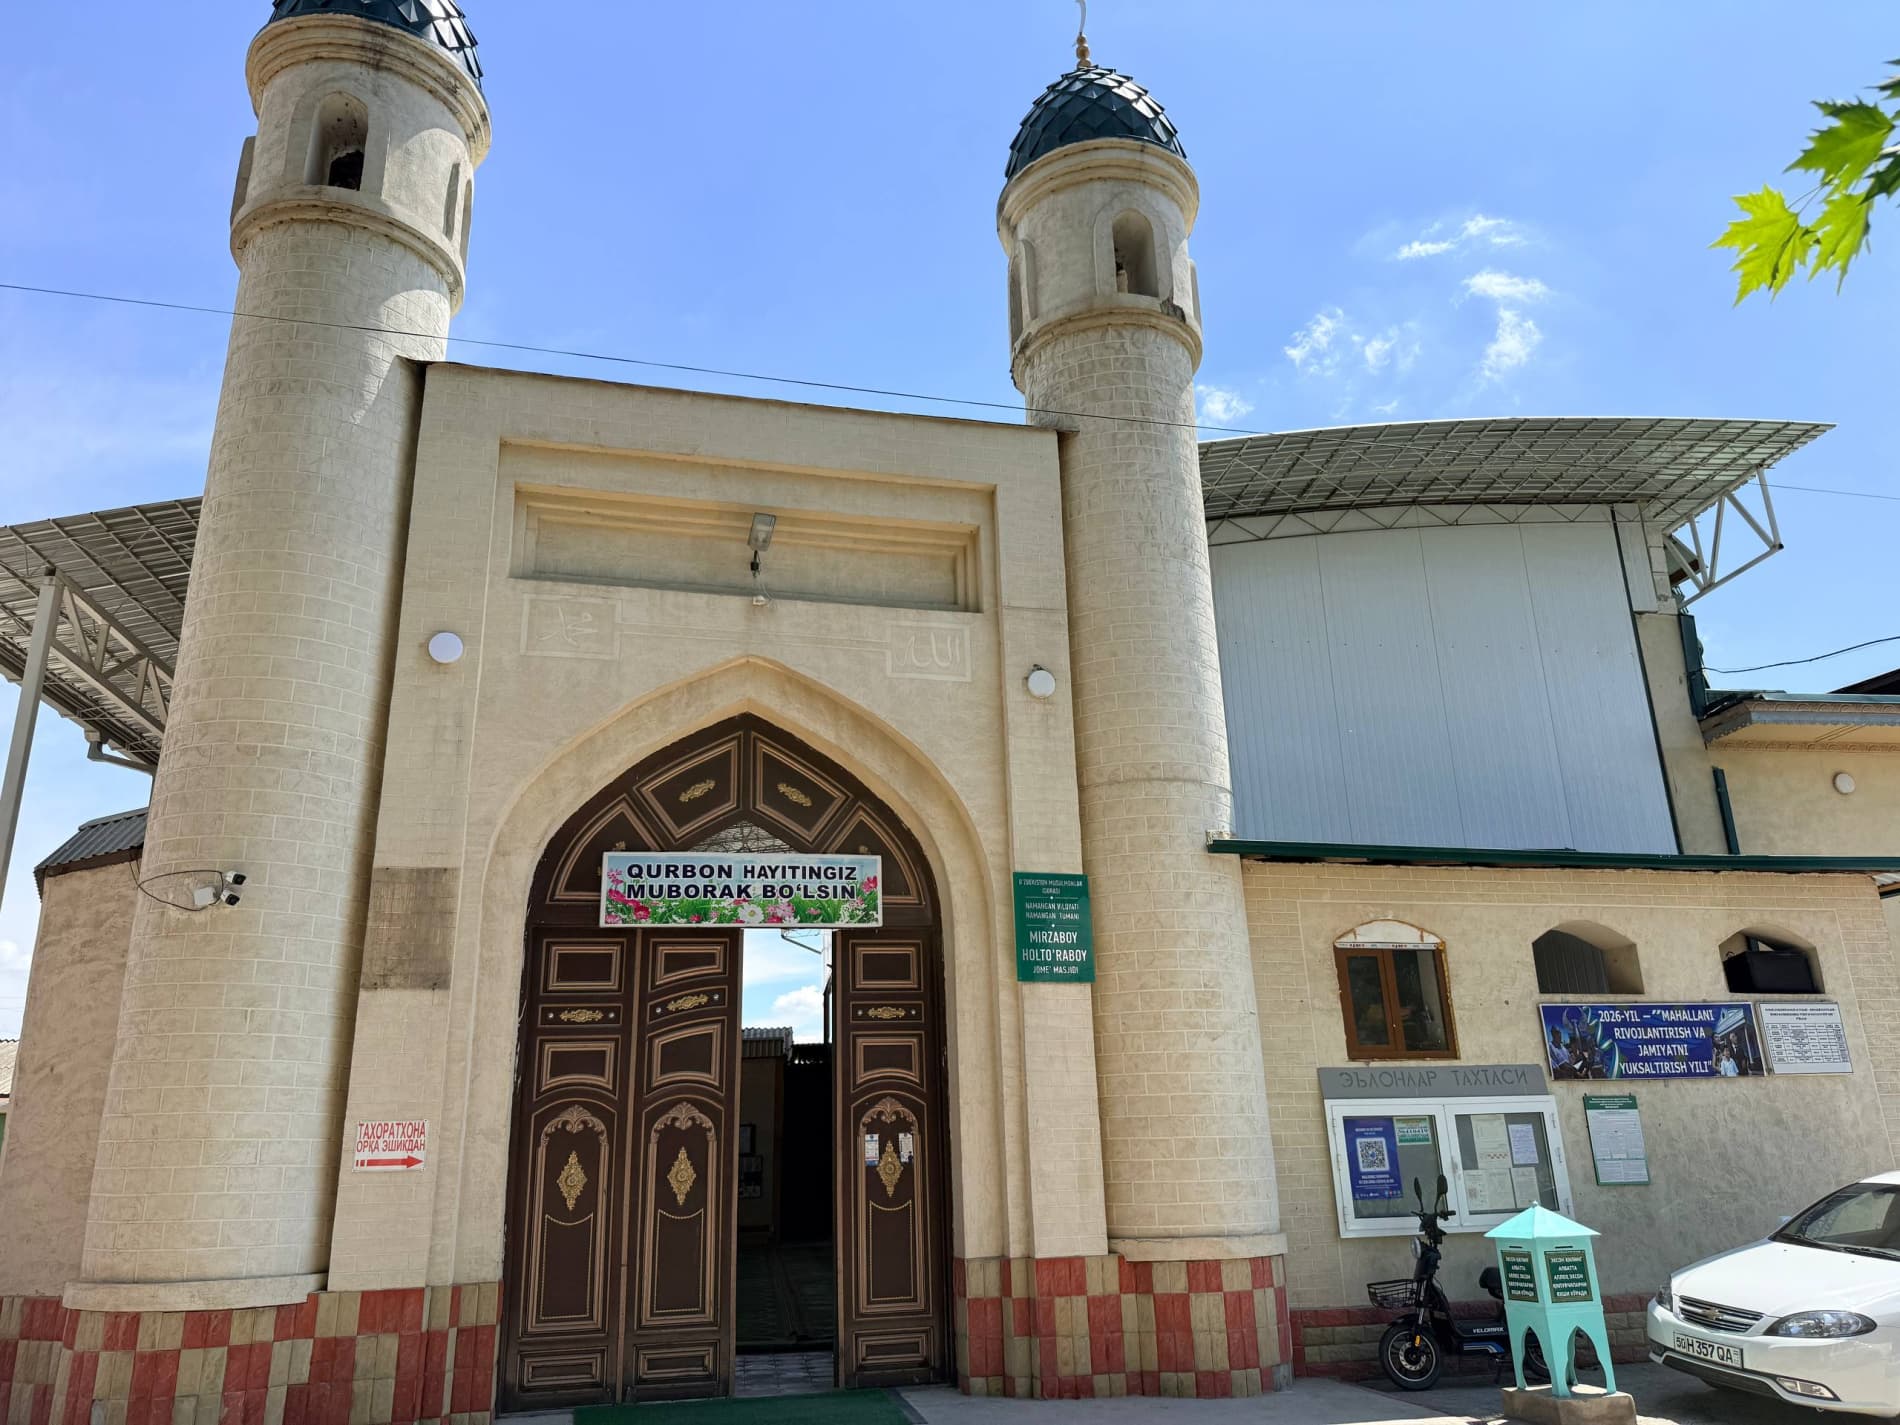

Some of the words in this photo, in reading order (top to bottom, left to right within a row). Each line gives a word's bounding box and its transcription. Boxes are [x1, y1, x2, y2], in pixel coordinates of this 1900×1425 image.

[627, 863, 733, 880] QURBON
[743, 864, 857, 881] HAYITINGIZ
[627, 884, 752, 899] MUBORAK
[1025, 902, 1056, 910] NAMANGAN
[1025, 911, 1056, 919] NAMANGAN
[1059, 912, 1080, 920] TUMANI
[1029, 931, 1078, 943] MIRZABOY
[1053, 966, 1079, 974] MASJIDI
[1598, 1010, 1640, 1023] 2026-YIL
[1614, 1027, 1691, 1040] RIVOJLANTIRISH
[1693, 1027, 1706, 1039] VA
[1638, 1044, 1689, 1057] JAMIYATNI
[1619, 1061, 1687, 1075] YUKSALTIRISH
[1339, 1071, 1437, 1088] ЭЪЛОНЛАР
[1452, 1069, 1528, 1086] ТАХТАСИ
[358, 1122, 426, 1139] ТАХОРАТХОНА
[1676, 1336, 1686, 1349] 50
